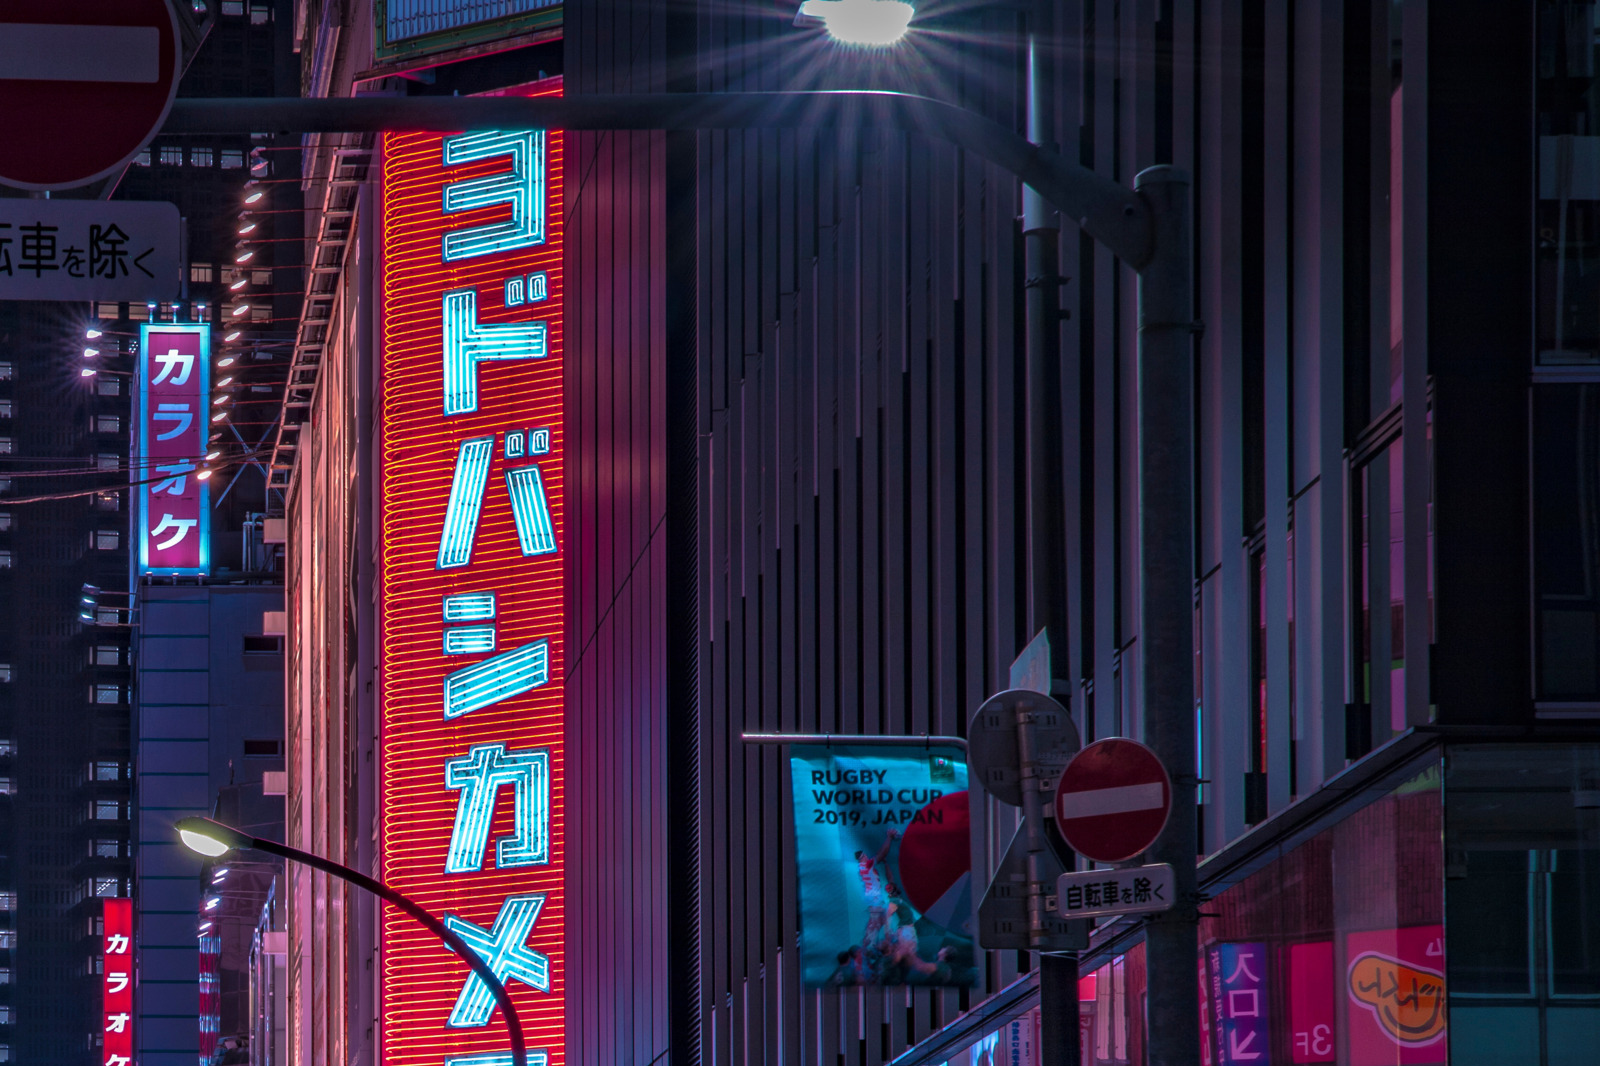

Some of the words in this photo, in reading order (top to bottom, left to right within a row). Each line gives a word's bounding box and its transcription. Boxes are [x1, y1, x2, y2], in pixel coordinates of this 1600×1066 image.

[151, 349, 198, 551] カラオケ
[811, 769, 888, 786] RUGBY
[813, 789, 892, 806] WORLD
[896, 789, 943, 806] CUP
[814, 809, 867, 828] 2019,
[870, 808, 943, 826] JAPAN
[1066, 876, 1166, 911] 自転車を除く
